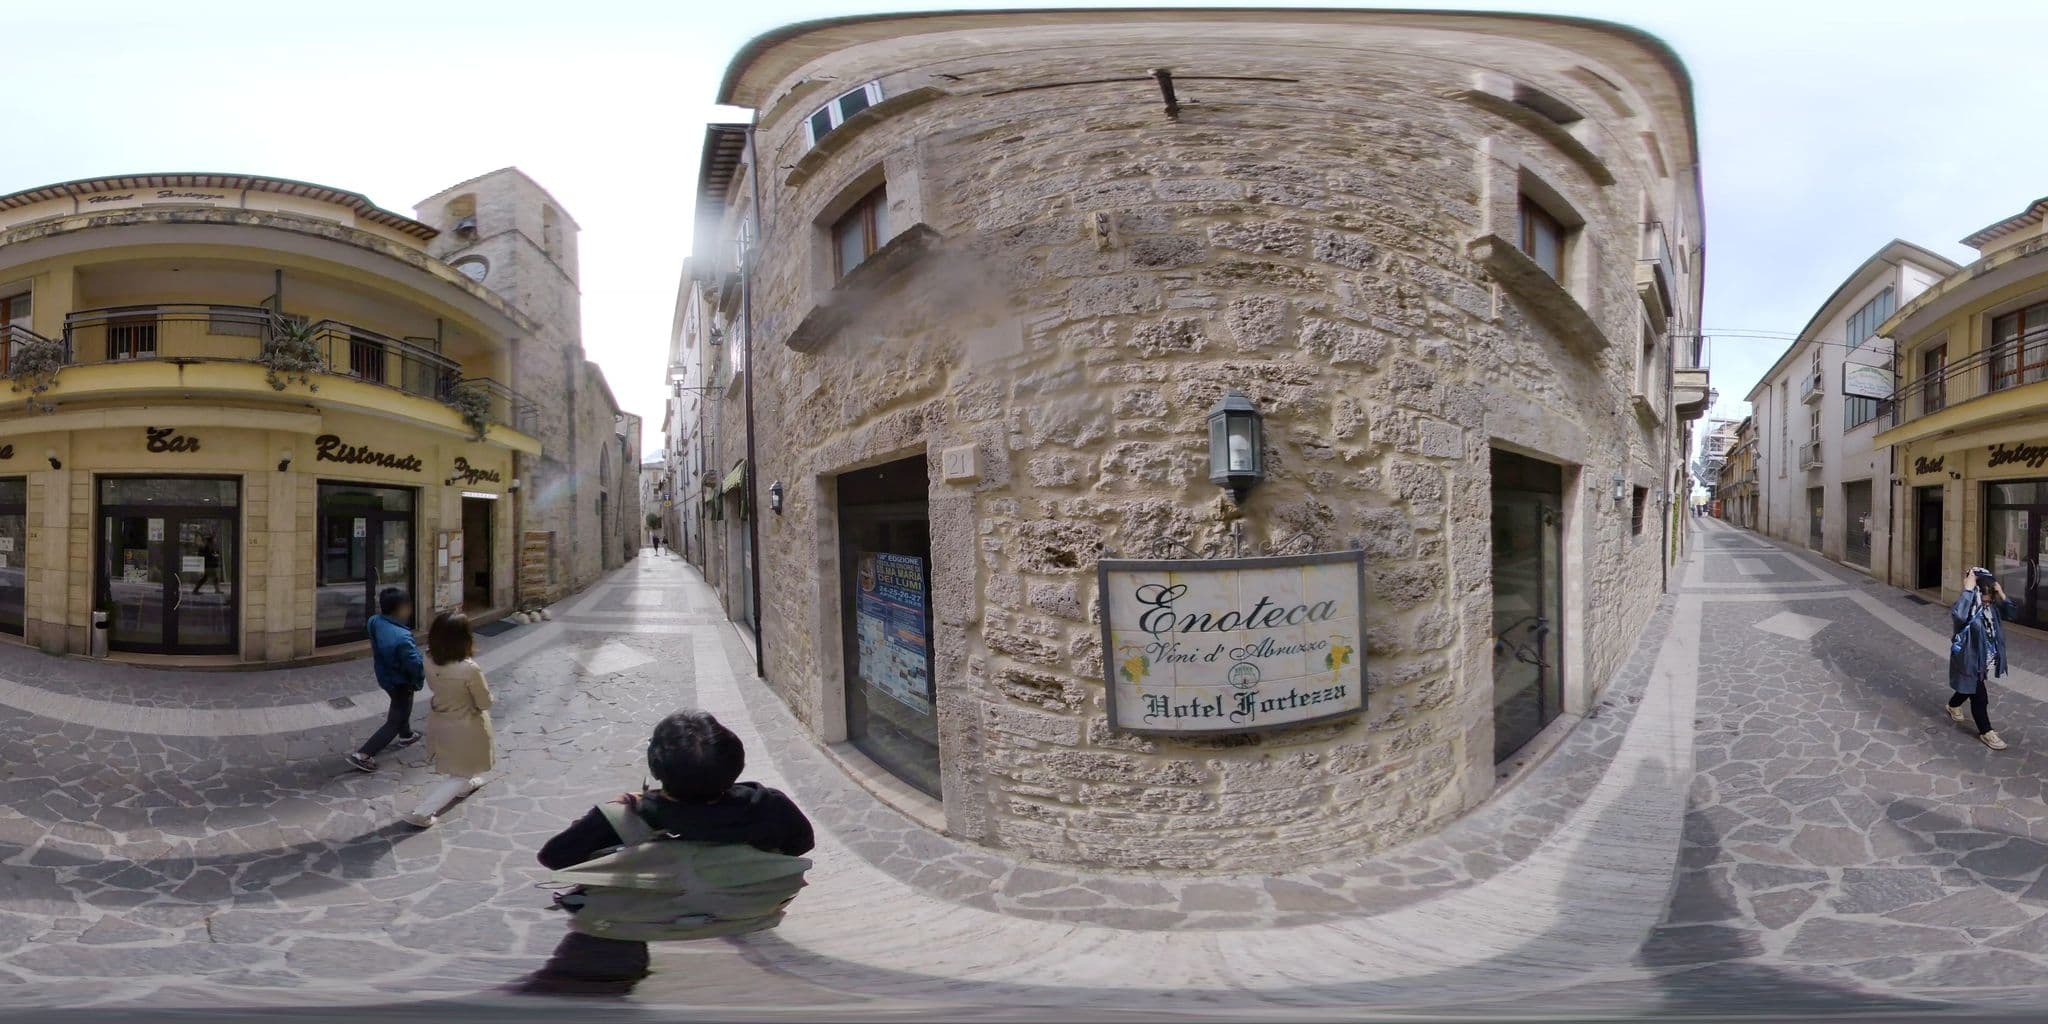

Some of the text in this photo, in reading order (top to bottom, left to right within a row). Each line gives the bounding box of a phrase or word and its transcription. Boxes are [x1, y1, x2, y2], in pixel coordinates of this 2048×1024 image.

[88, 194, 134, 204] Hotel
[146, 426, 201, 453] Bar
[315, 434, 423, 473] Ristorante
[950, 453, 966, 475] 21
[1914, 455, 1945, 476] Hotel
[878, 574, 922, 591] DEI LUMI
[899, 567, 923, 581] MARIA
[1135, 583, 1337, 640] Enoteca
[1146, 641, 1198, 664] Vini
[1229, 636, 1328, 661] Abruzzo
[1142, 684, 1347, 725] Hotel Fortezza
